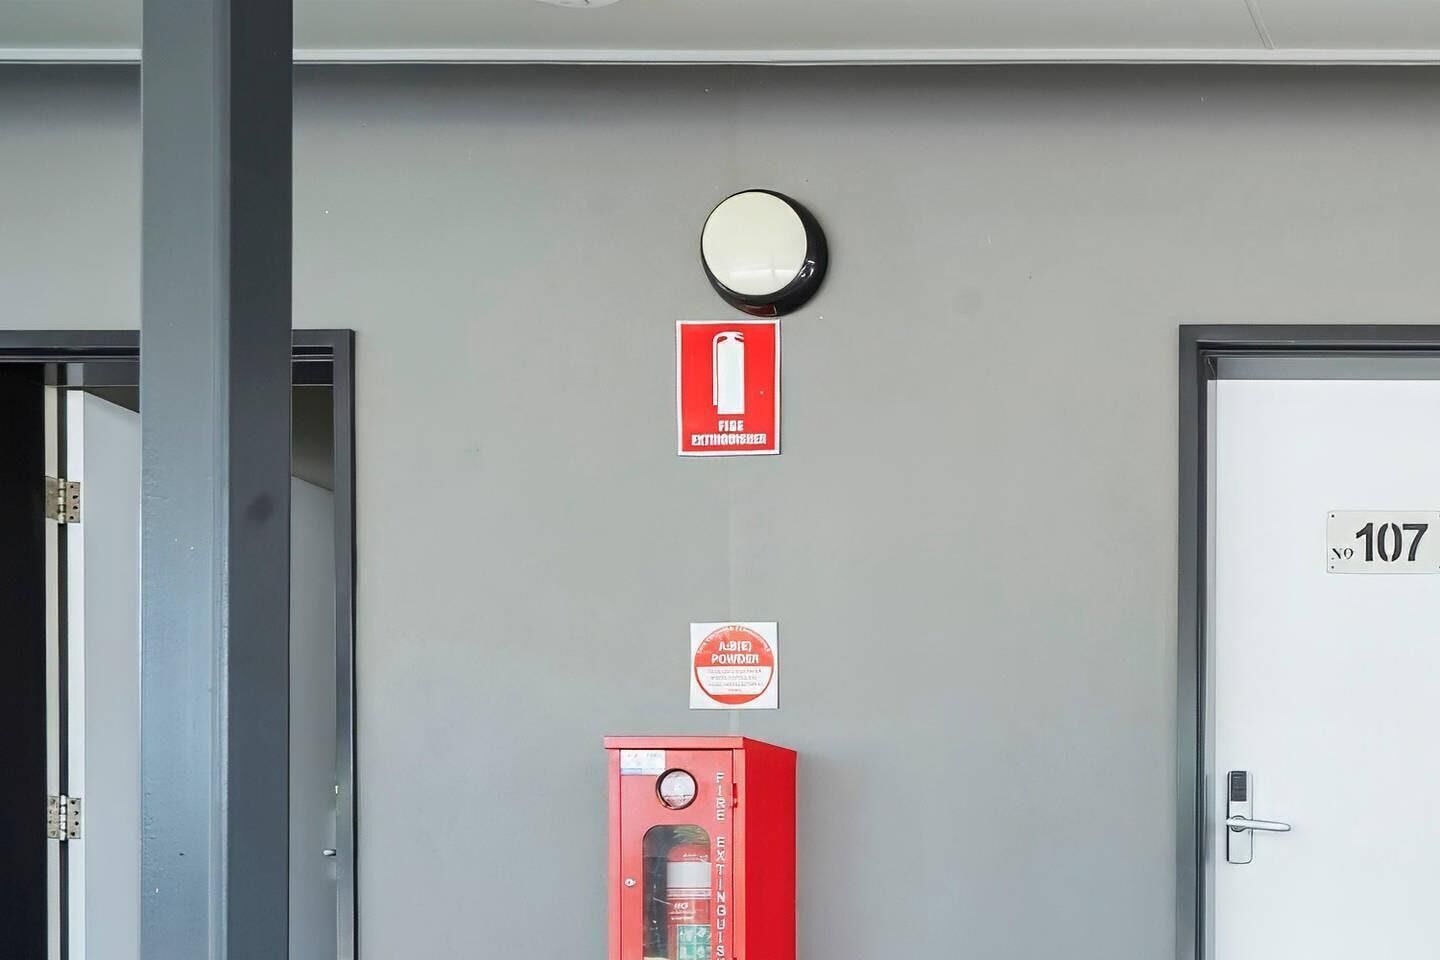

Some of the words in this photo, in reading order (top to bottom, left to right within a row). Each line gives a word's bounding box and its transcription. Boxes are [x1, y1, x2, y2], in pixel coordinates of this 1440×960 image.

[718, 420, 744, 432] FIRE
[691, 433, 767, 446] EXTINGUISHER
[1355, 522, 1429, 562] 107
[711, 653, 759, 665] POWDER
[716, 772, 726, 820] FIRE
